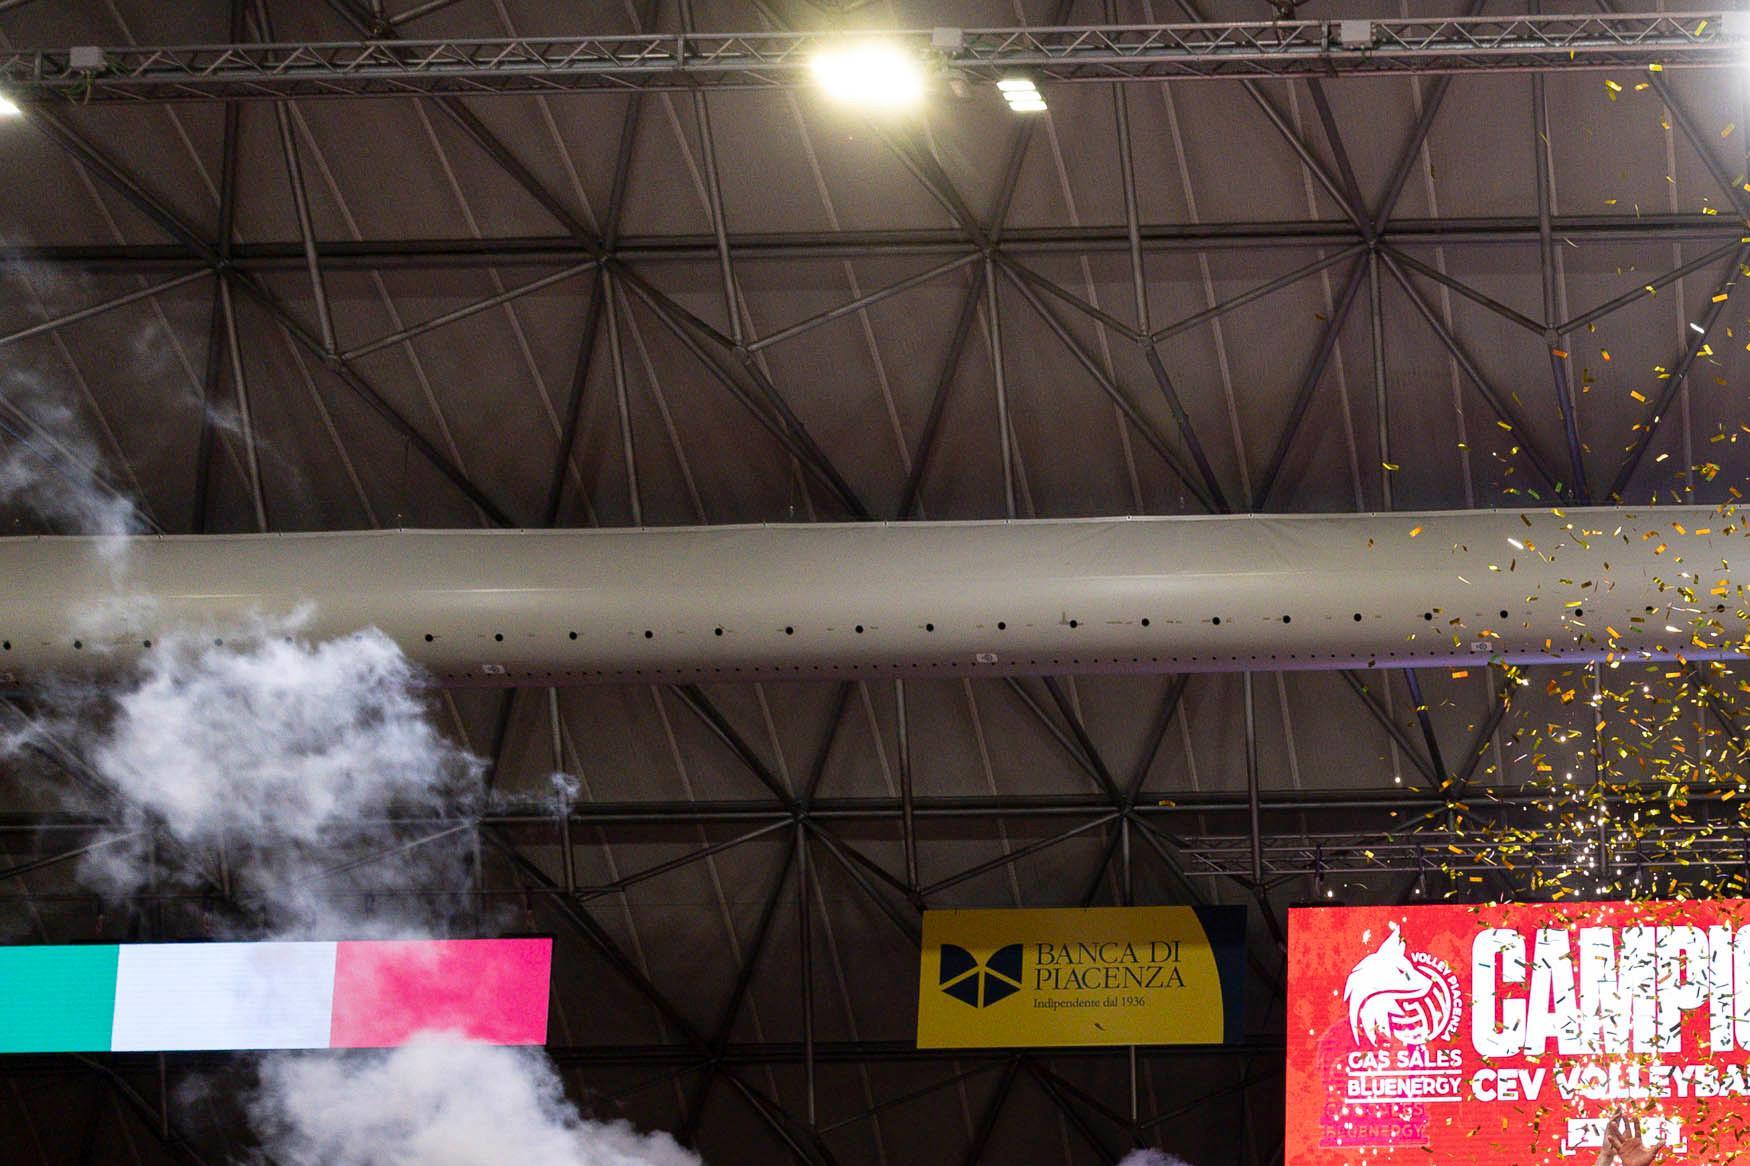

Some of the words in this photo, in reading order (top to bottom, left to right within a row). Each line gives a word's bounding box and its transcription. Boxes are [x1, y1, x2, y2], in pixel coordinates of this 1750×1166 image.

[1035, 941, 1140, 965] BANCA
[1150, 940, 1182, 963] DI
[1411, 952, 1452, 976] VOLLEY
[1034, 966, 1186, 991] PIACENZA
[1033, 997, 1100, 1011] Indipendente
[1103, 997, 1118, 1008] dal
[1122, 997, 1145, 1008] 1936
[1348, 1051, 1390, 1068] GAS
[1397, 1050, 1462, 1067] SALES
[1348, 1077, 1461, 1096] BLUENERGY
[1472, 1067, 1545, 1101] CEV
